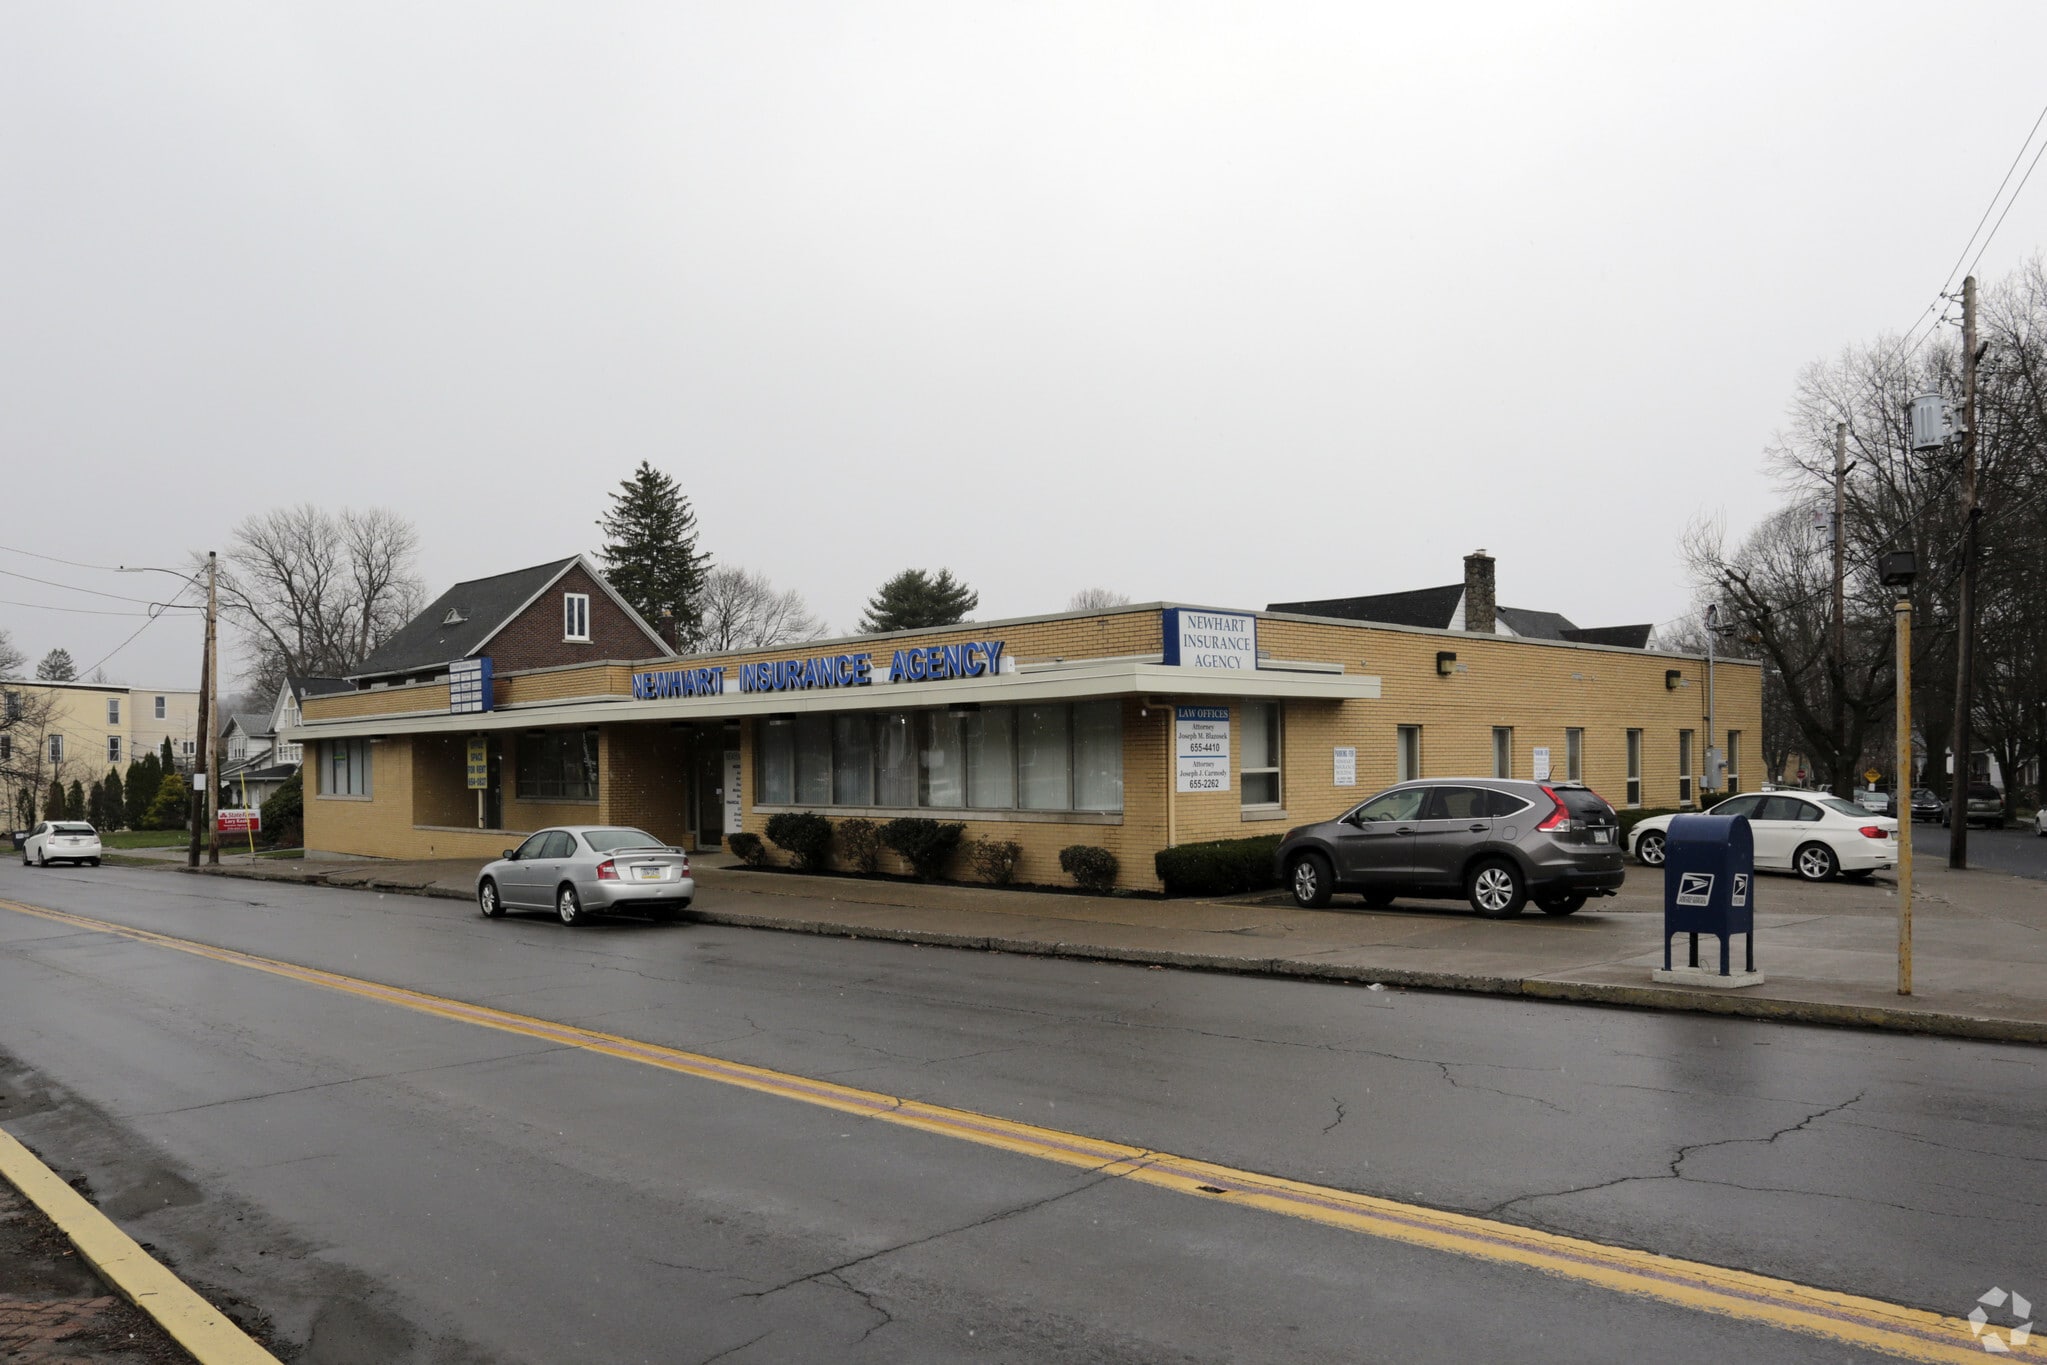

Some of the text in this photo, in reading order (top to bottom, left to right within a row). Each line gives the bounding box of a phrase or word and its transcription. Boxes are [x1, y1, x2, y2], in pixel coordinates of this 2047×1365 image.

[1187, 615, 1246, 632] NEWHART
[1184, 634, 1250, 650] INSURANCE
[1194, 654, 1241, 669] AGENCY
[632, 641, 1005, 699] NEWHART INSURANCE AGENCY
[1178, 708, 1229, 718] LAW OFFICES
[1192, 723, 1214, 732] Attorney
[1178, 732, 1198, 741] Joseph
[1190, 743, 1220, 752] 655-4410
[1192, 761, 1214, 769] Attorney
[1180, 770, 1198, 778] Joseph
[1190, 779, 1219, 788] 655-2262
